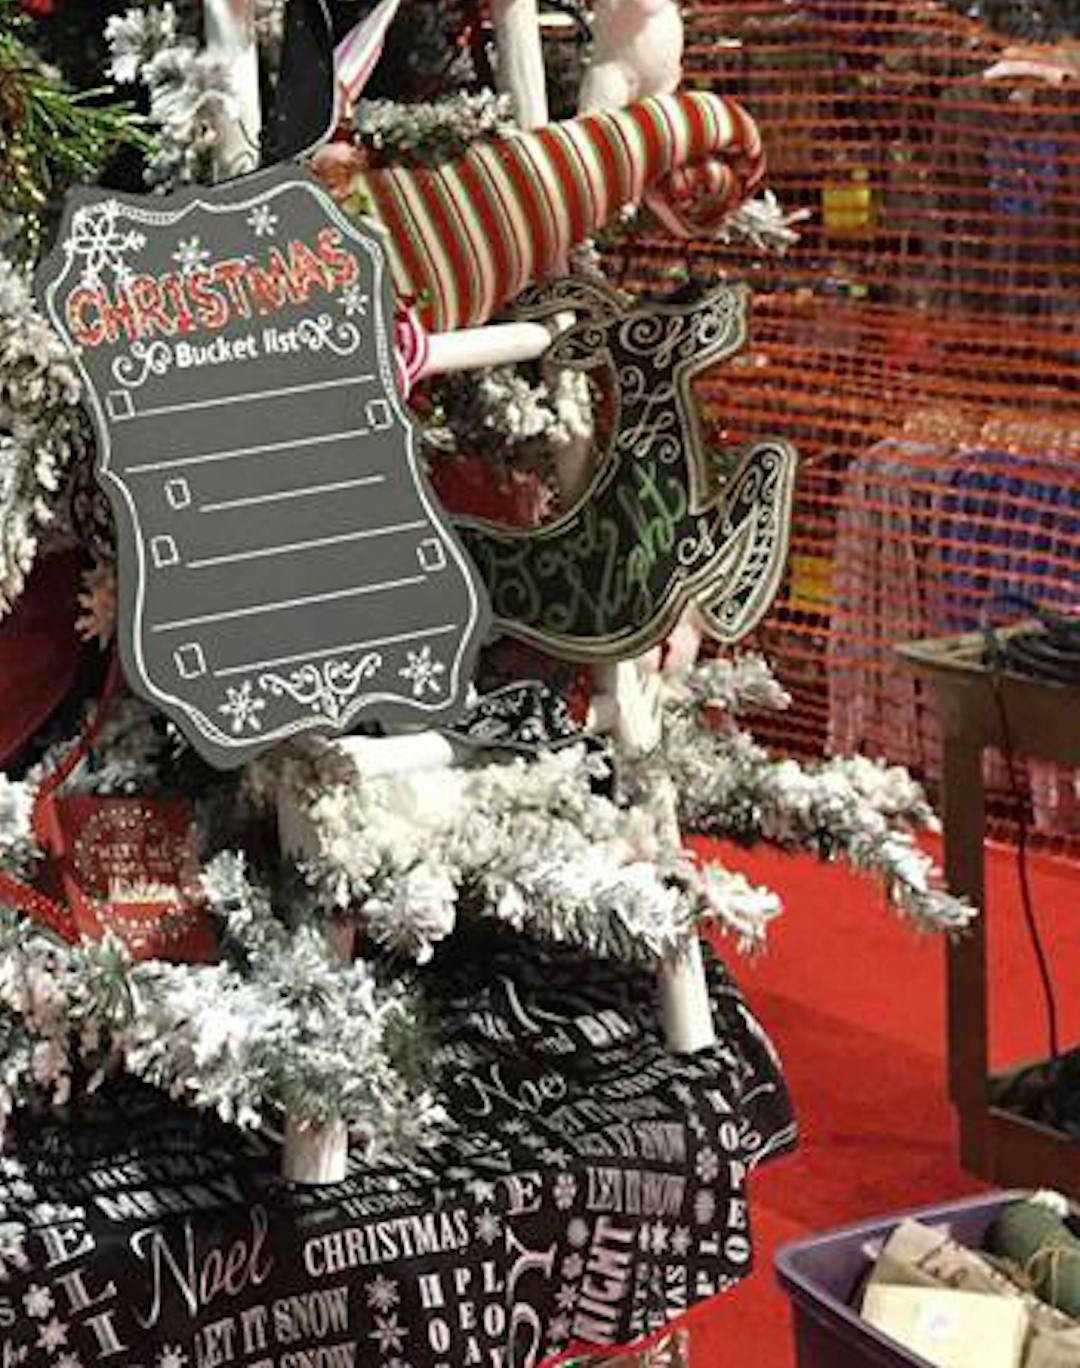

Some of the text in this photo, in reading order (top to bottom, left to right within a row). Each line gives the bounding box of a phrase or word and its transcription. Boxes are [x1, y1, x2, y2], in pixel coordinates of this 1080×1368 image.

[65, 227, 360, 346] CHRISTMAS
[174, 327, 303, 369] Bucket list
[128, 1203, 273, 1330] Noel
[303, 1208, 471, 1278] CHRISTMAS
[240, 1304, 268, 1355] IT
[272, 1285, 349, 1345] SNOW
